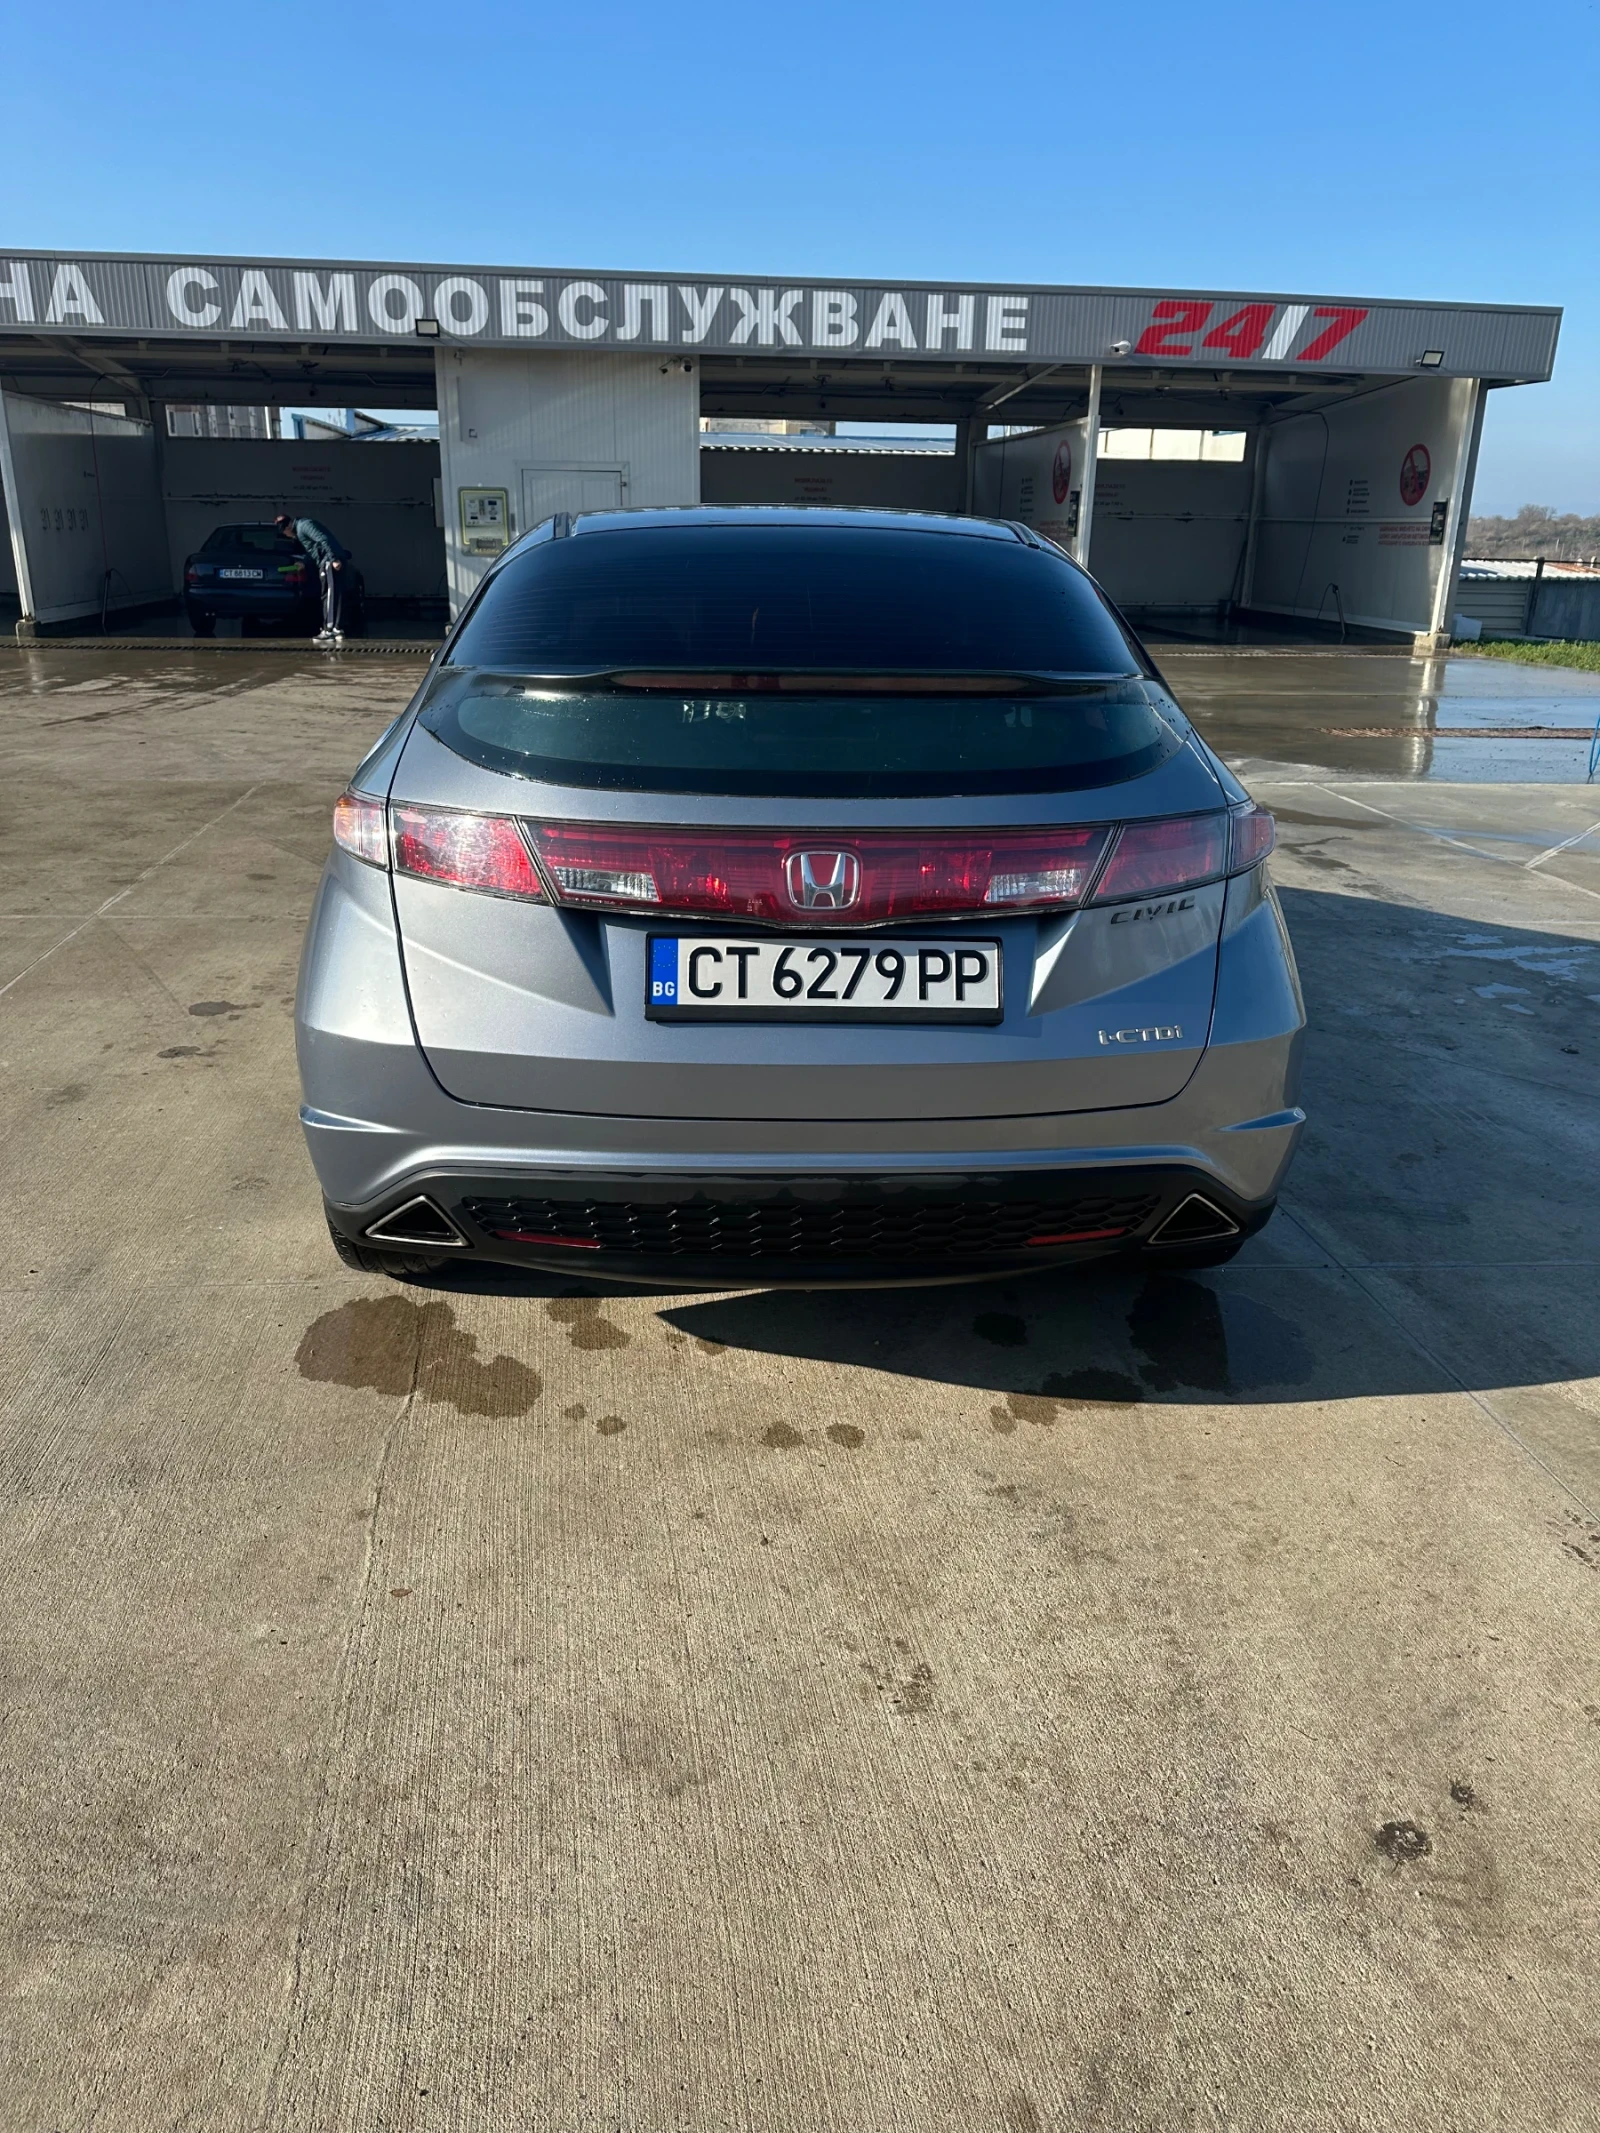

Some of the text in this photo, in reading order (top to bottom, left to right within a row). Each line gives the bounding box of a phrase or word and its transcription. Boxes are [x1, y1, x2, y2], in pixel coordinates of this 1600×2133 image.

[166, 266, 1030, 352] САМООБСЛУЖВАНЕ
[1134, 299, 1370, 361] 24/7
[1110, 895, 1196, 925] CIVIC
[652, 981, 676, 998] BG
[688, 946, 988, 1002] CT 6279 PP
